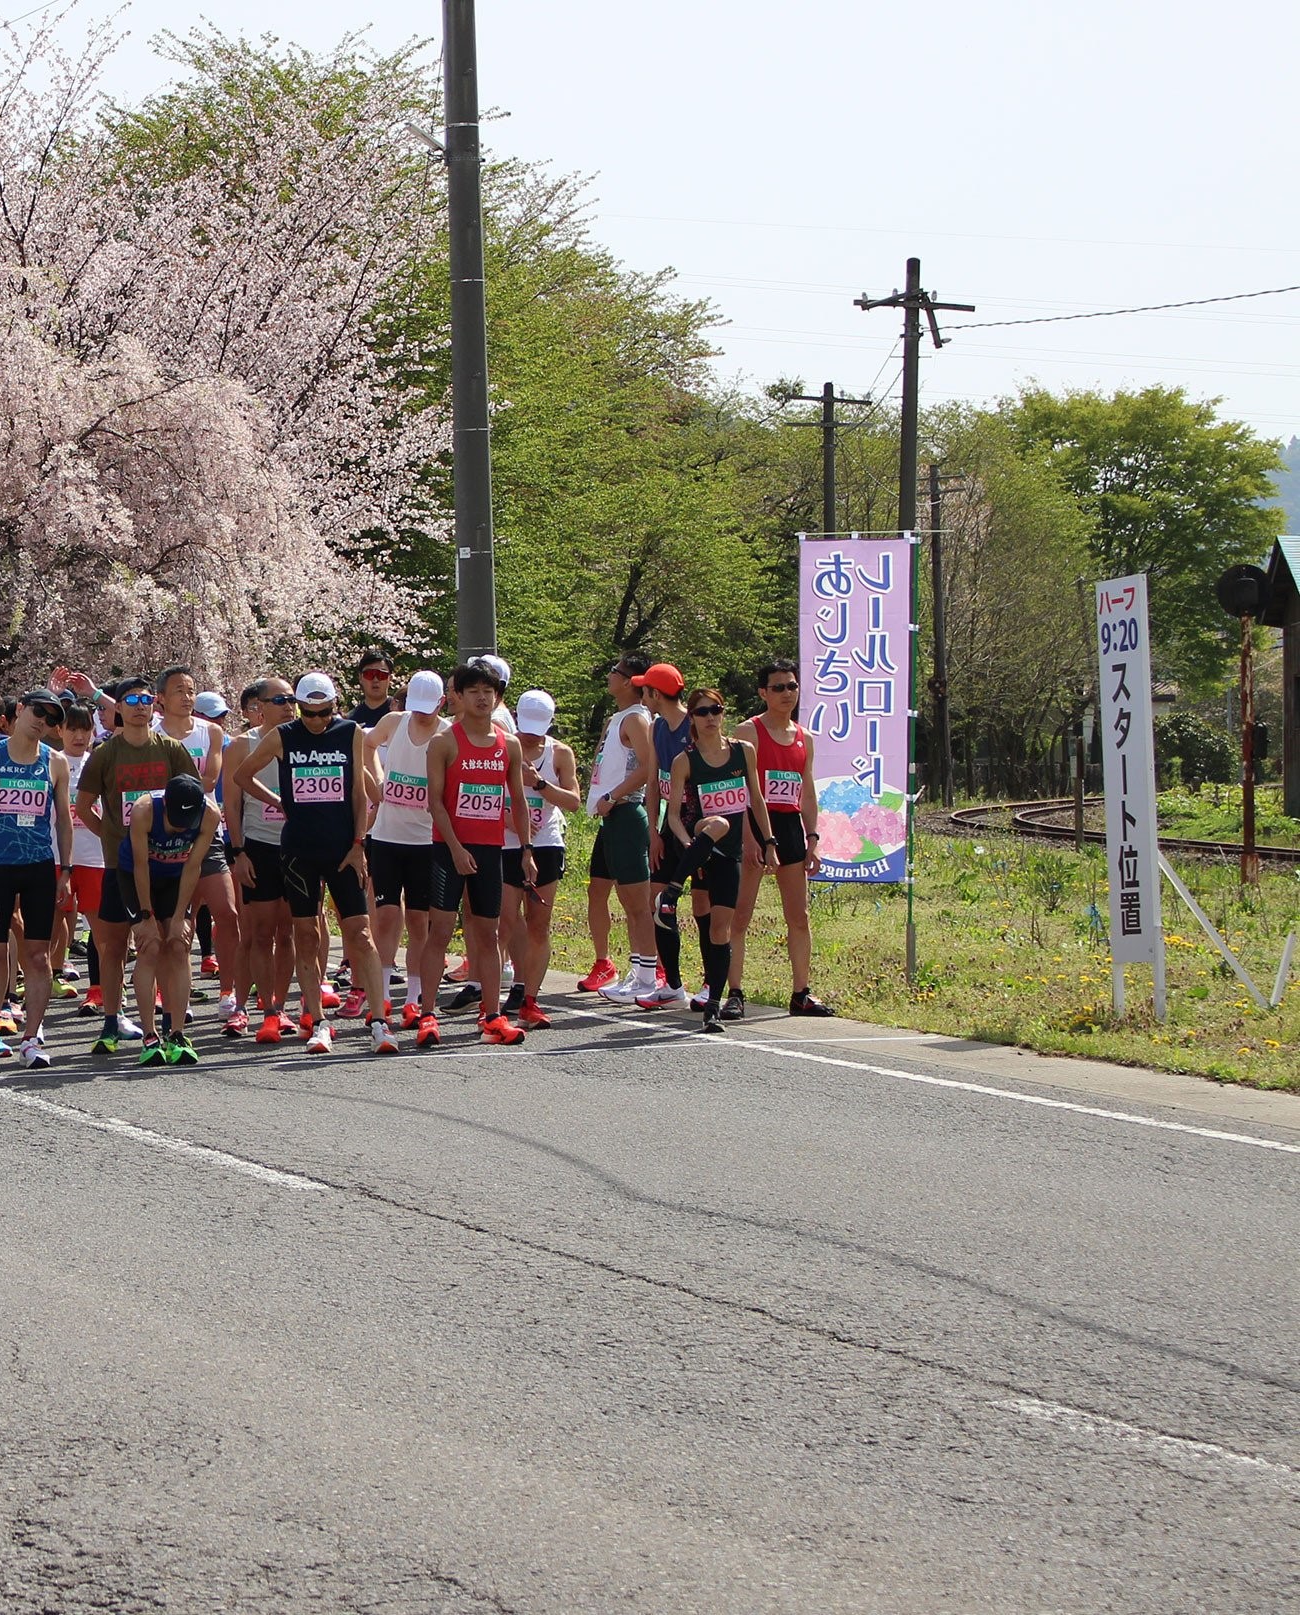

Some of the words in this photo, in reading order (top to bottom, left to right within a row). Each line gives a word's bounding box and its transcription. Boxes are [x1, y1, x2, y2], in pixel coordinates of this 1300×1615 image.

[1099, 587, 1135, 615] ハーフ
[1101, 617, 1138, 655] 9:20
[289, 751, 307, 764] No
[308, 750, 347, 765] Apple
[304, 767, 332, 775] ITOKU
[8, 780, 36, 788] ITOKU
[294, 778, 342, 793] 2306
[394, 774, 419, 784] ITOKU
[710, 781, 736, 791] ITOKU
[386, 781, 426, 801] 2030
[471, 785, 496, 793] ITOKU
[459, 794, 501, 811] 2054
[702, 788, 746, 809] 2606
[1111, 662, 1142, 936] スタート位置
